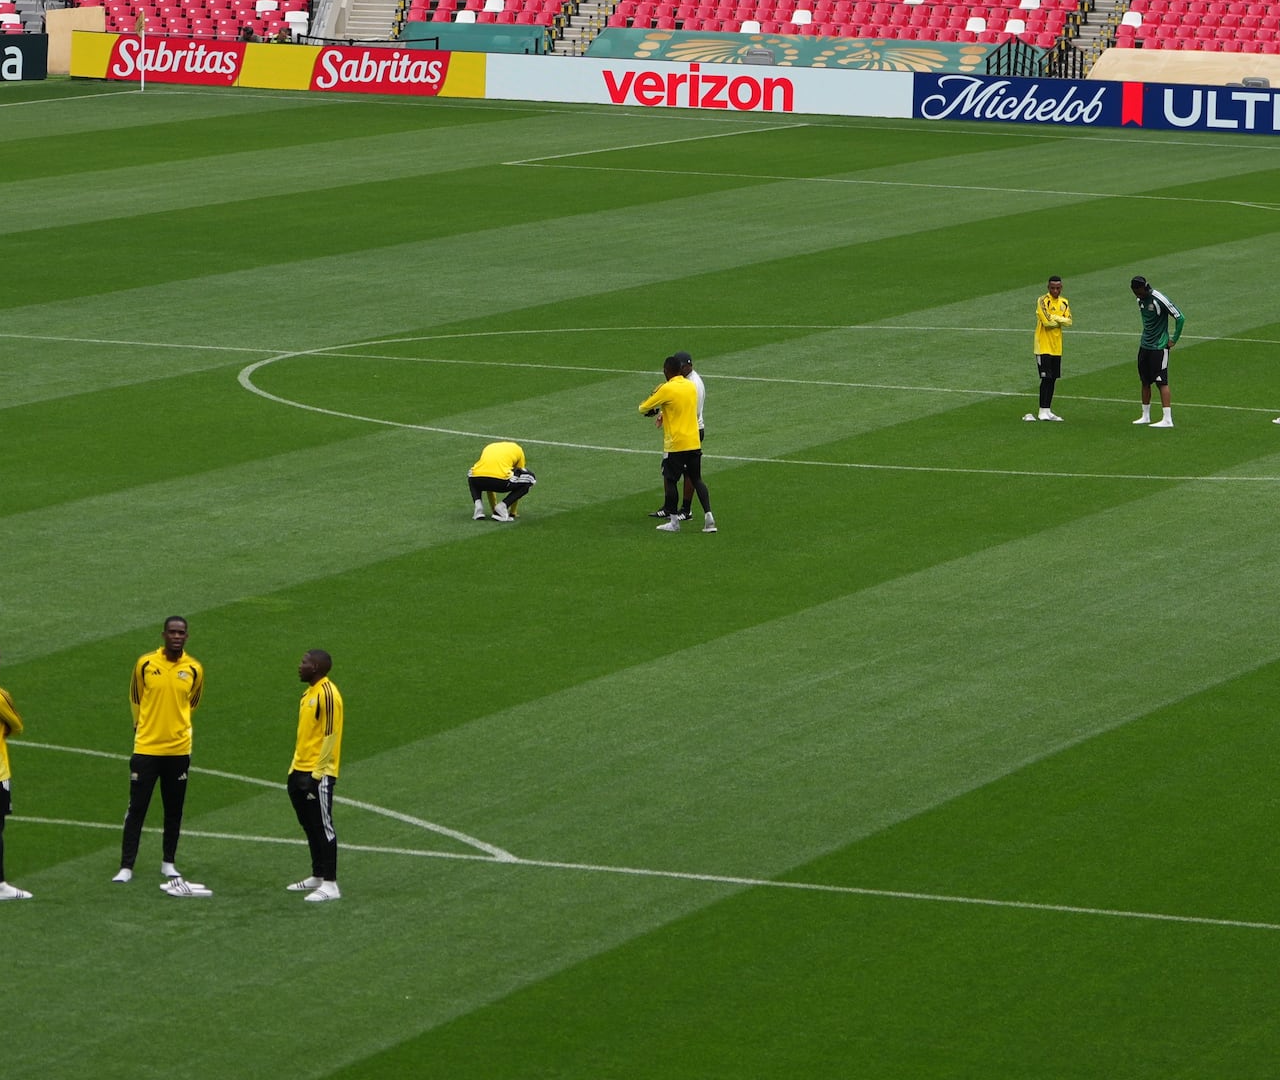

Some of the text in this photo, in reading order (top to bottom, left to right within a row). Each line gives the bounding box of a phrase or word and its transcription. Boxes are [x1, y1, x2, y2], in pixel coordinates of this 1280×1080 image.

[113, 38, 238, 77] Sabritas
[316, 50, 443, 89] Sabritas
[602, 62, 794, 113] verizon
[920, 74, 1103, 125] Michelob
